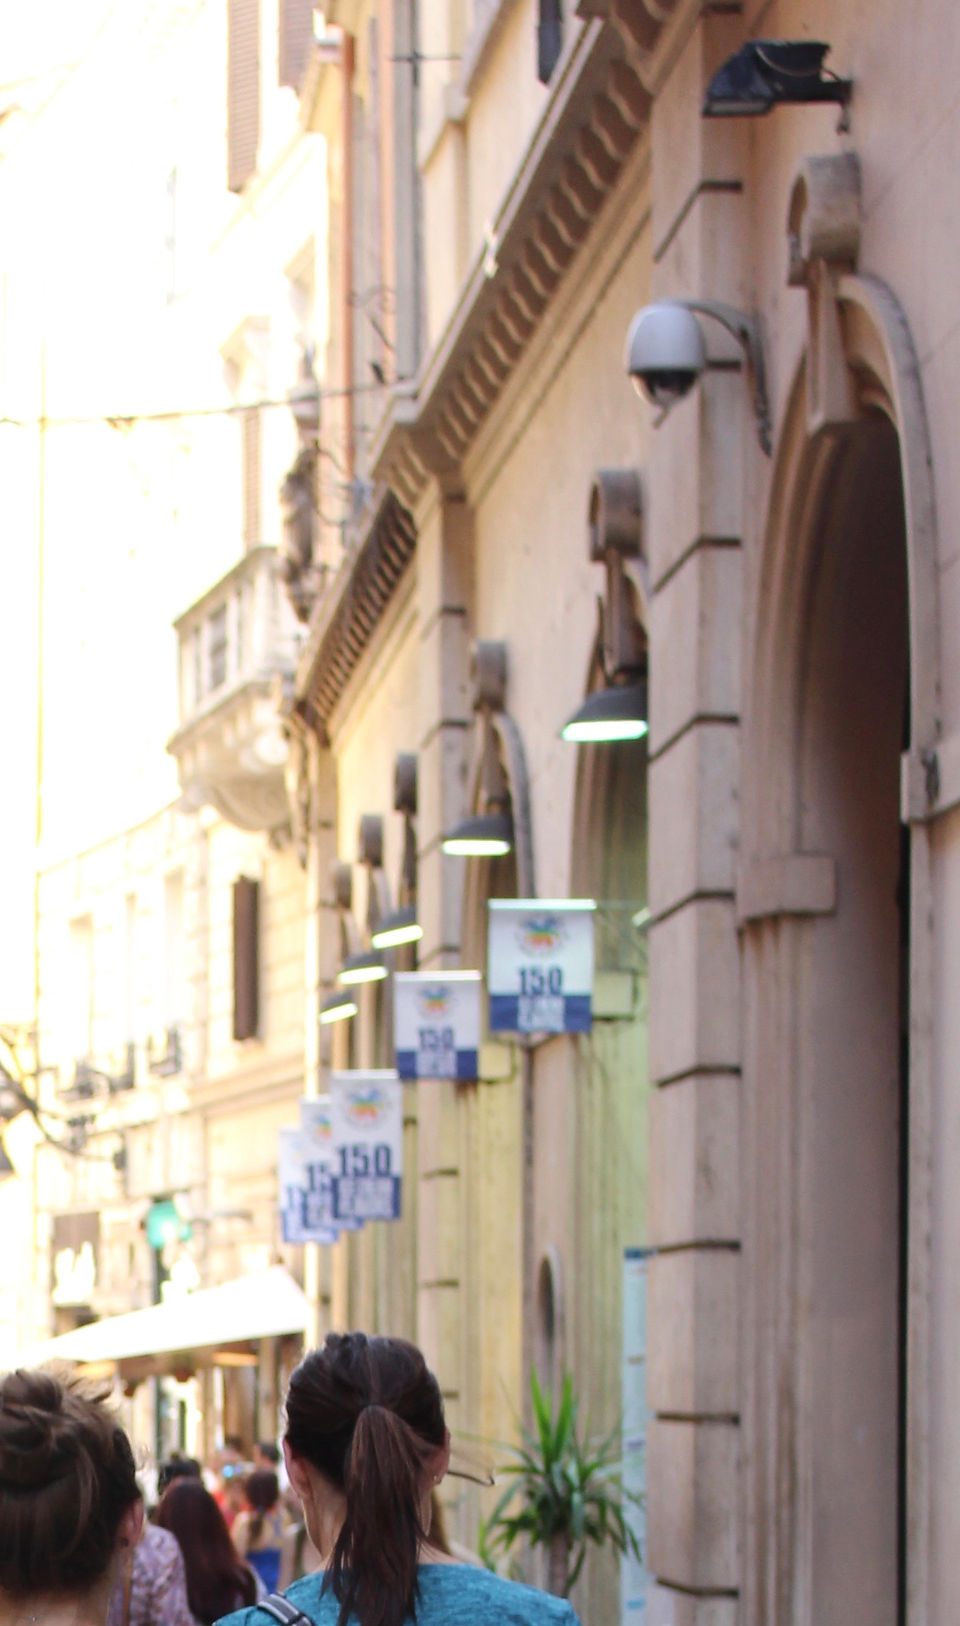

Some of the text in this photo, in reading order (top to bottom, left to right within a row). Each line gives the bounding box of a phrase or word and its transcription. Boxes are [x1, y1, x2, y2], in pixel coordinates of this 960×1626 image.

[519, 966, 562, 996] 150
[417, 1027, 454, 1052] 150
[337, 1144, 391, 1178] 150
[306, 1161, 333, 1192] 15
